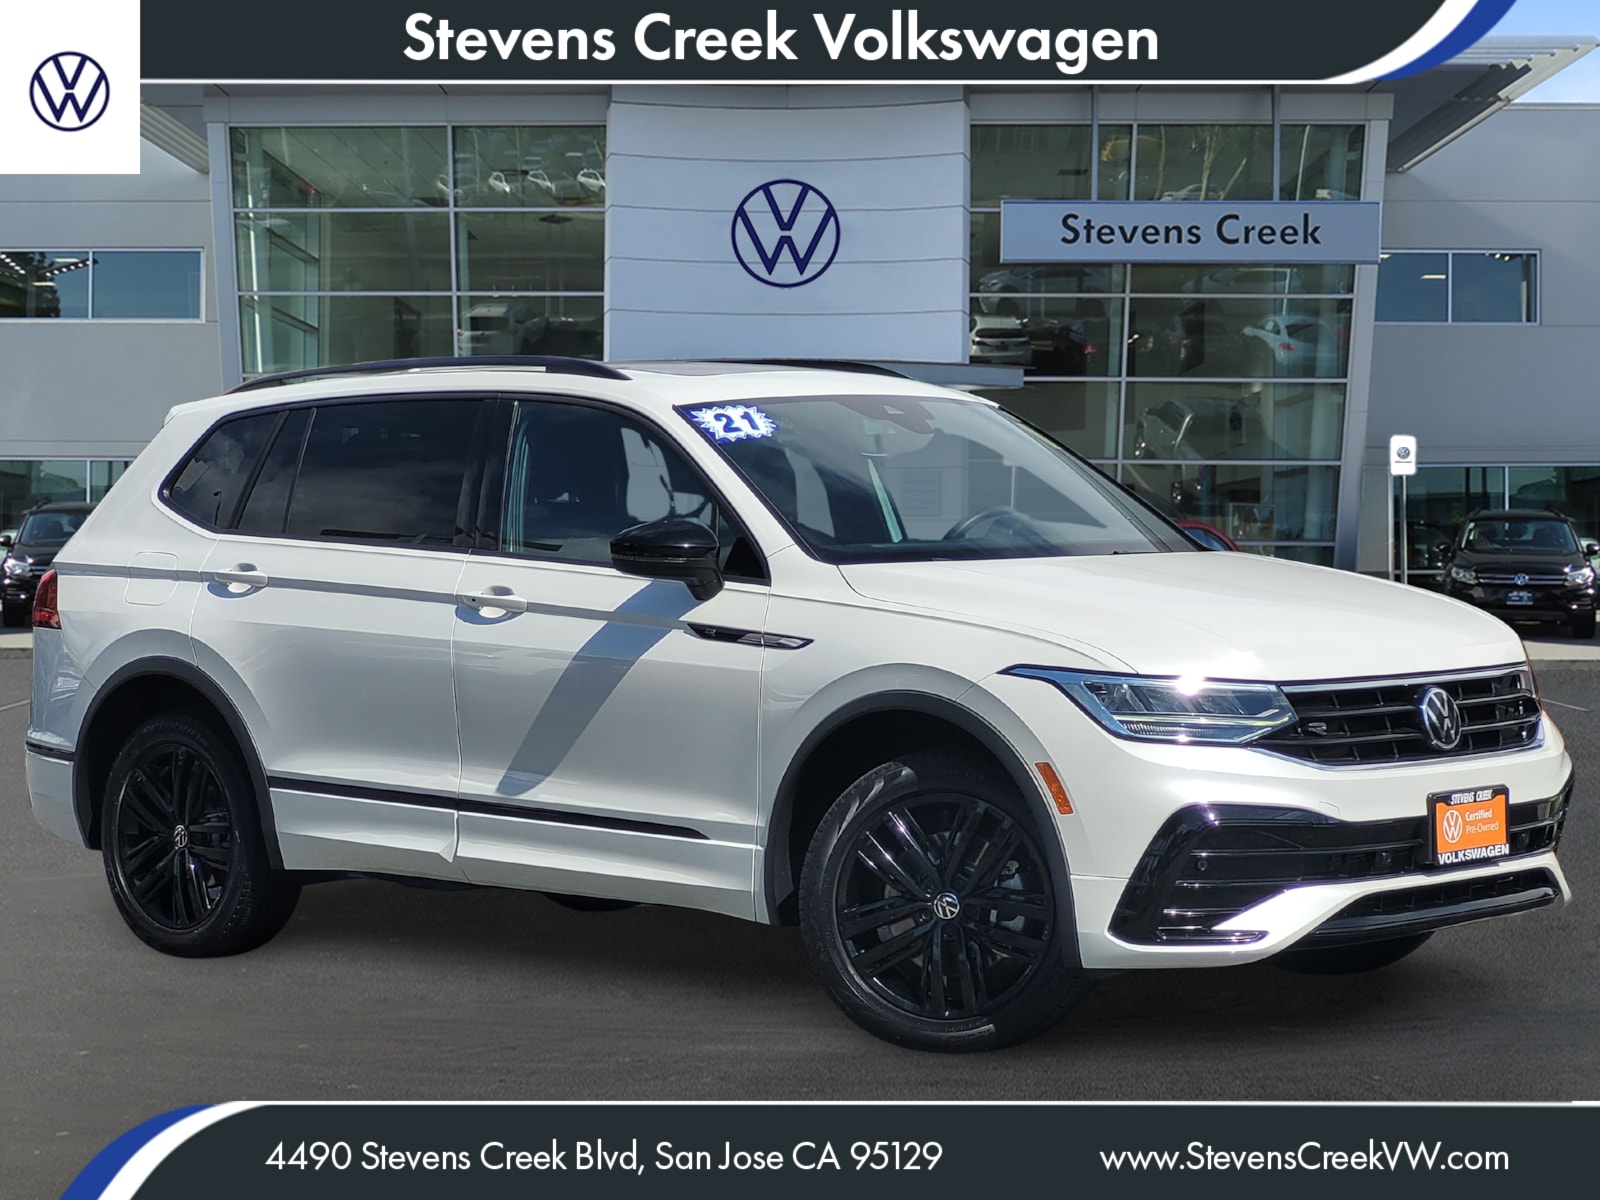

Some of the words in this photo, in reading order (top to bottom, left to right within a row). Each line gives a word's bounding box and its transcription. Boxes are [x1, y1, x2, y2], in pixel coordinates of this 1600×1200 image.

[731, 179, 841, 288] VW
[1061, 213, 1201, 245] Stevens
[1217, 213, 1321, 245] Creek
[714, 411, 760, 433] 21
[1423, 688, 1462, 749] VW
[1451, 791, 1475, 805] STEVENS
[1476, 789, 1493, 802] CREEK
[1465, 808, 1492, 821] Certified
[1443, 809, 1463, 843] VW
[1466, 822, 1499, 834] Pre-Owned
[1439, 844, 1510, 865] VOLKSWAGEN
